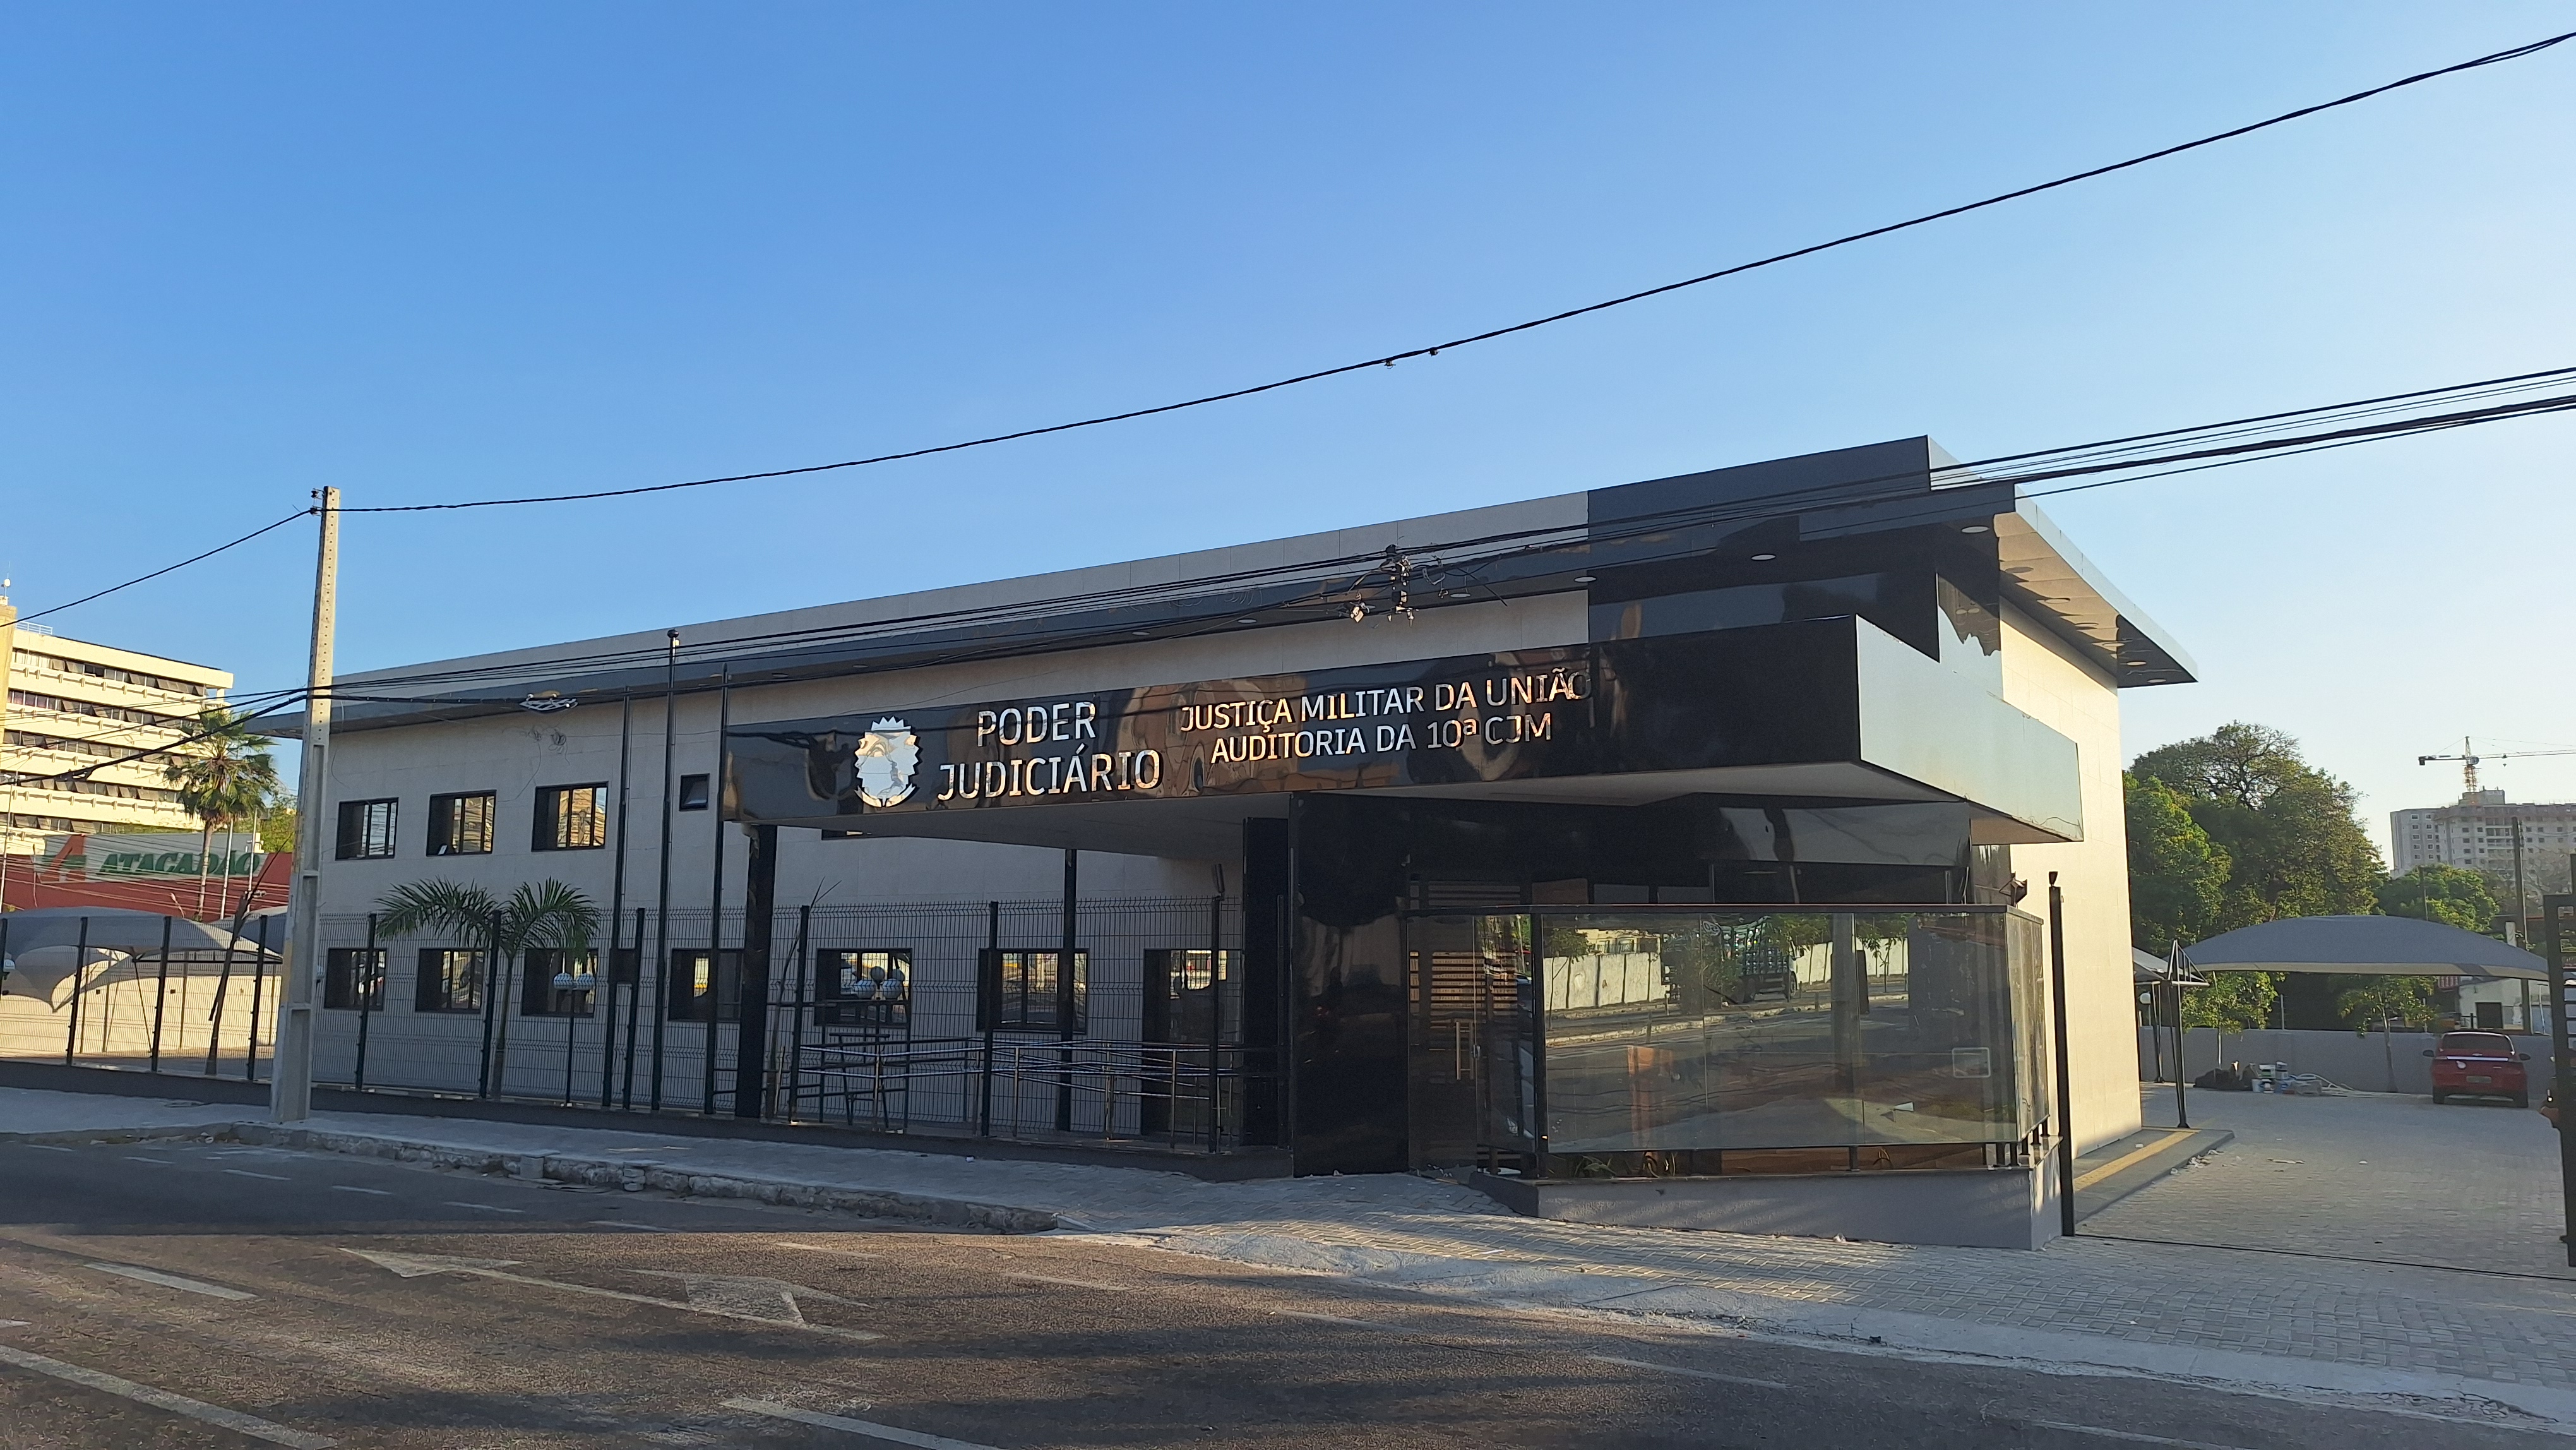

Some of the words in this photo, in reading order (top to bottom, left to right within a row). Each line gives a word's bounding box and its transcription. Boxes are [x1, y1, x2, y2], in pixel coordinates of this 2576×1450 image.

[977, 702, 1096, 746] PODER
[1181, 698, 1292, 733] JUSTIÇA
[1301, 686, 1424, 721] MILITAR
[1434, 683, 1478, 710] DA
[1486, 667, 1592, 706] UNIÃO
[1211, 728, 1366, 764] AUDITORIA
[1376, 724, 1416, 752] DA
[1485, 712, 1553, 745] CJM
[938, 743, 1162, 801] JUDICIÁRIO
